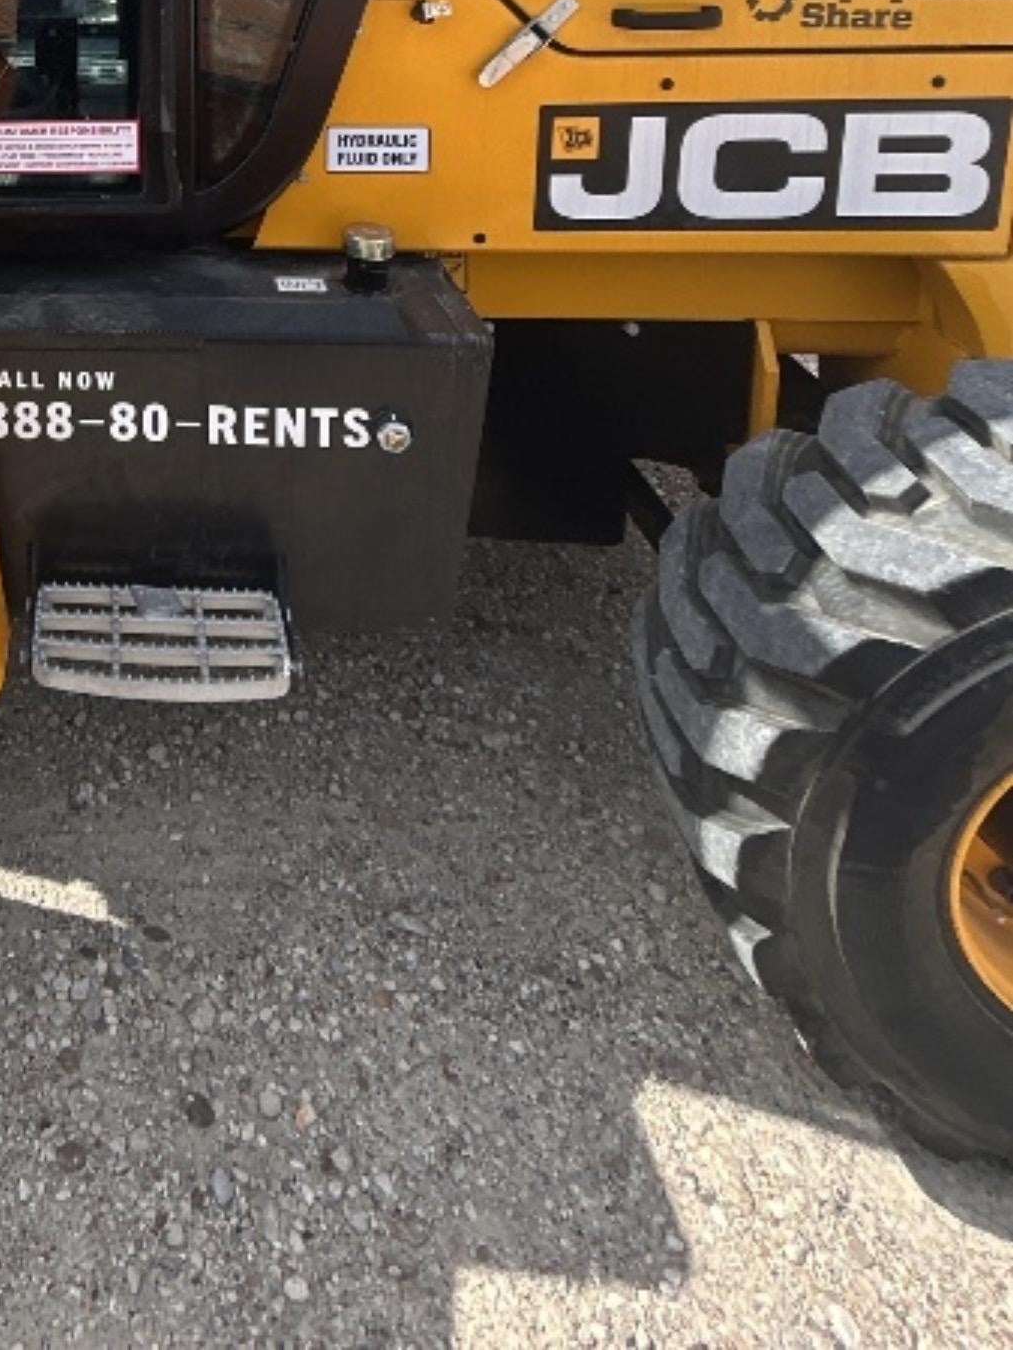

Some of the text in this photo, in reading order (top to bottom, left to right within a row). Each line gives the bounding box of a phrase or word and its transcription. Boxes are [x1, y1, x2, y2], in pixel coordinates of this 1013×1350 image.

[800, 3, 913, 29] Share
[337, 134, 417, 148] HYDRAULIC
[337, 152, 378, 166] FLUID
[548, 111, 991, 220] JCB
[58, 370, 116, 391] NOW
